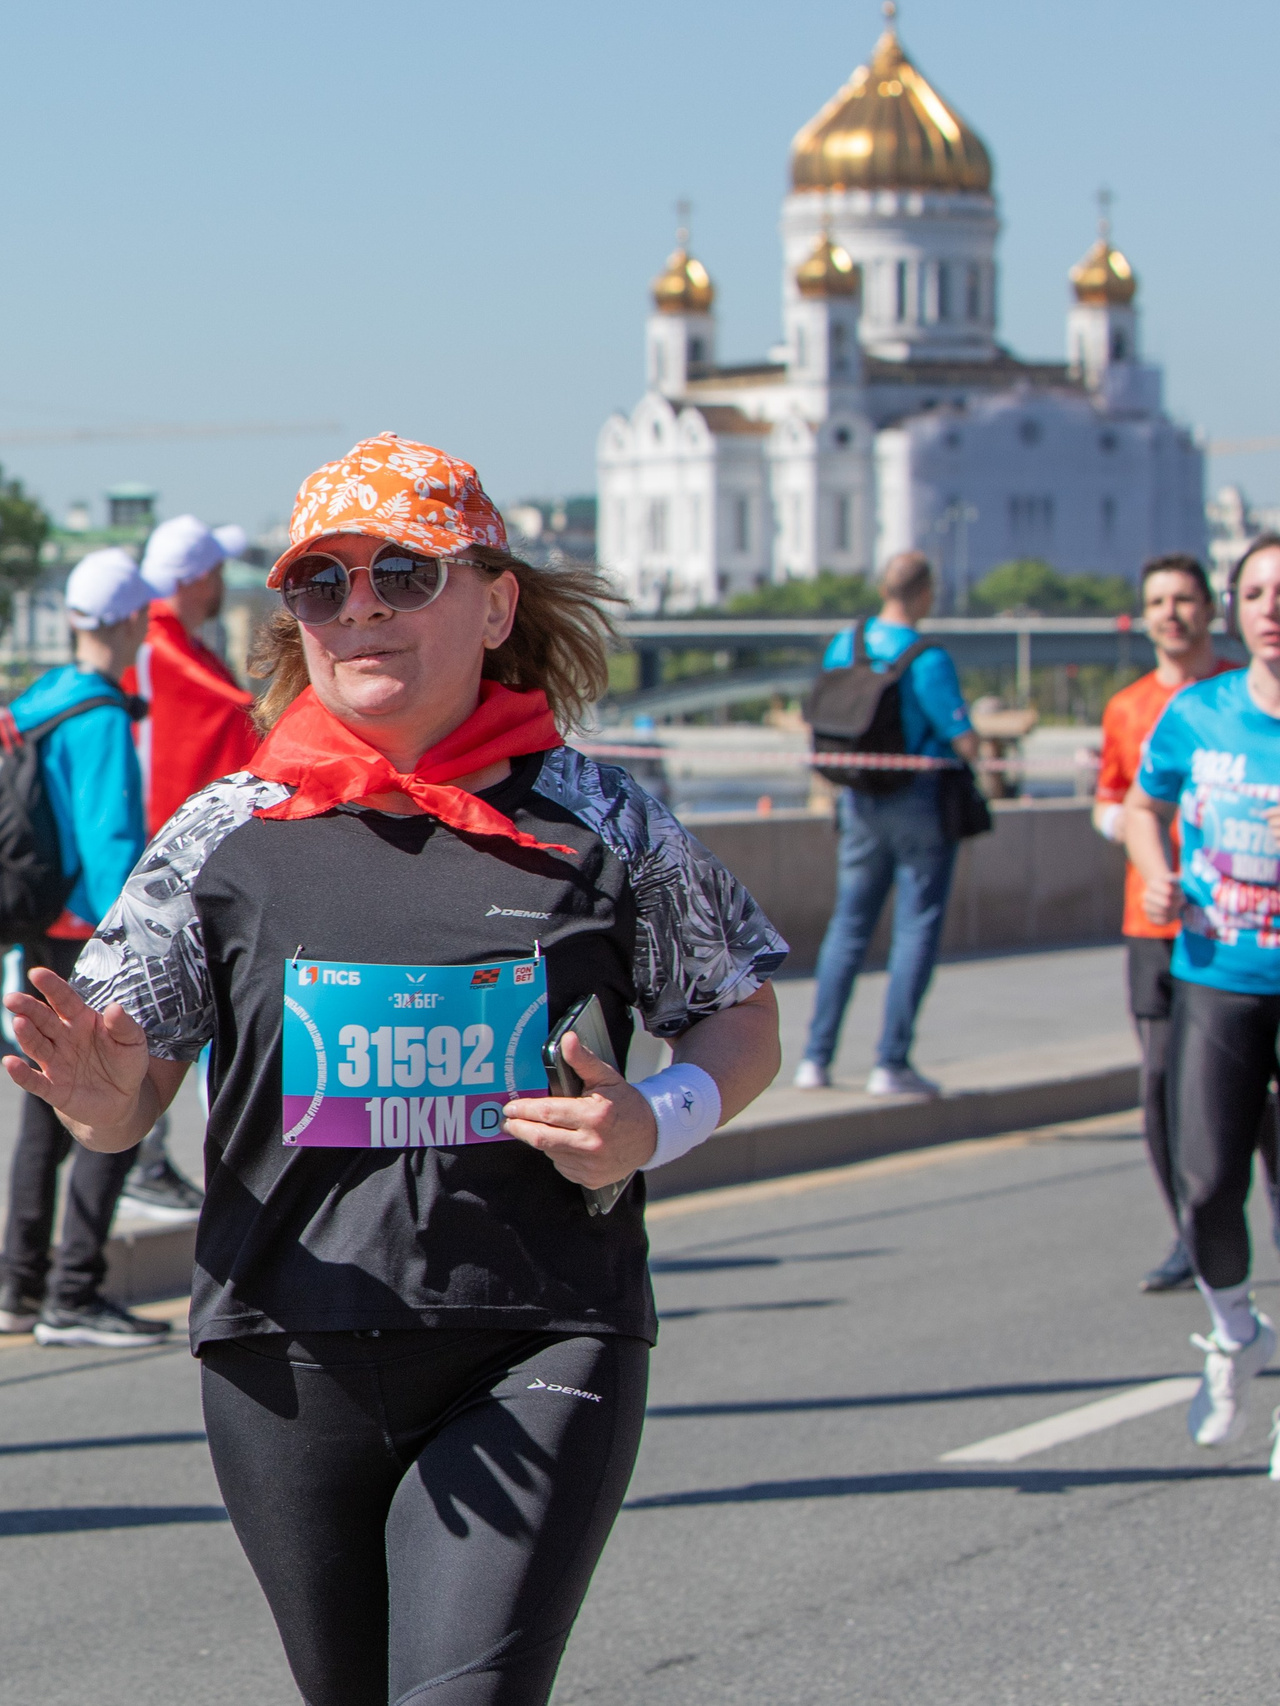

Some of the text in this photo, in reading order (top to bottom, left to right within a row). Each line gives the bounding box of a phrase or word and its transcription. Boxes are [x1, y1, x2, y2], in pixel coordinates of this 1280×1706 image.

[501, 909, 552, 919] DEMIX
[322, 970, 362, 986] ПСБ
[515, 966, 532, 975] FON
[515, 974, 532, 982] BET
[337, 1024, 495, 1088] 31592
[306, 1090, 324, 1117] #ТРЕПЕТ
[365, 1096, 466, 1147] 10KM
[481, 1108, 500, 1130] D
[547, 1384, 602, 1402] DEMIX
